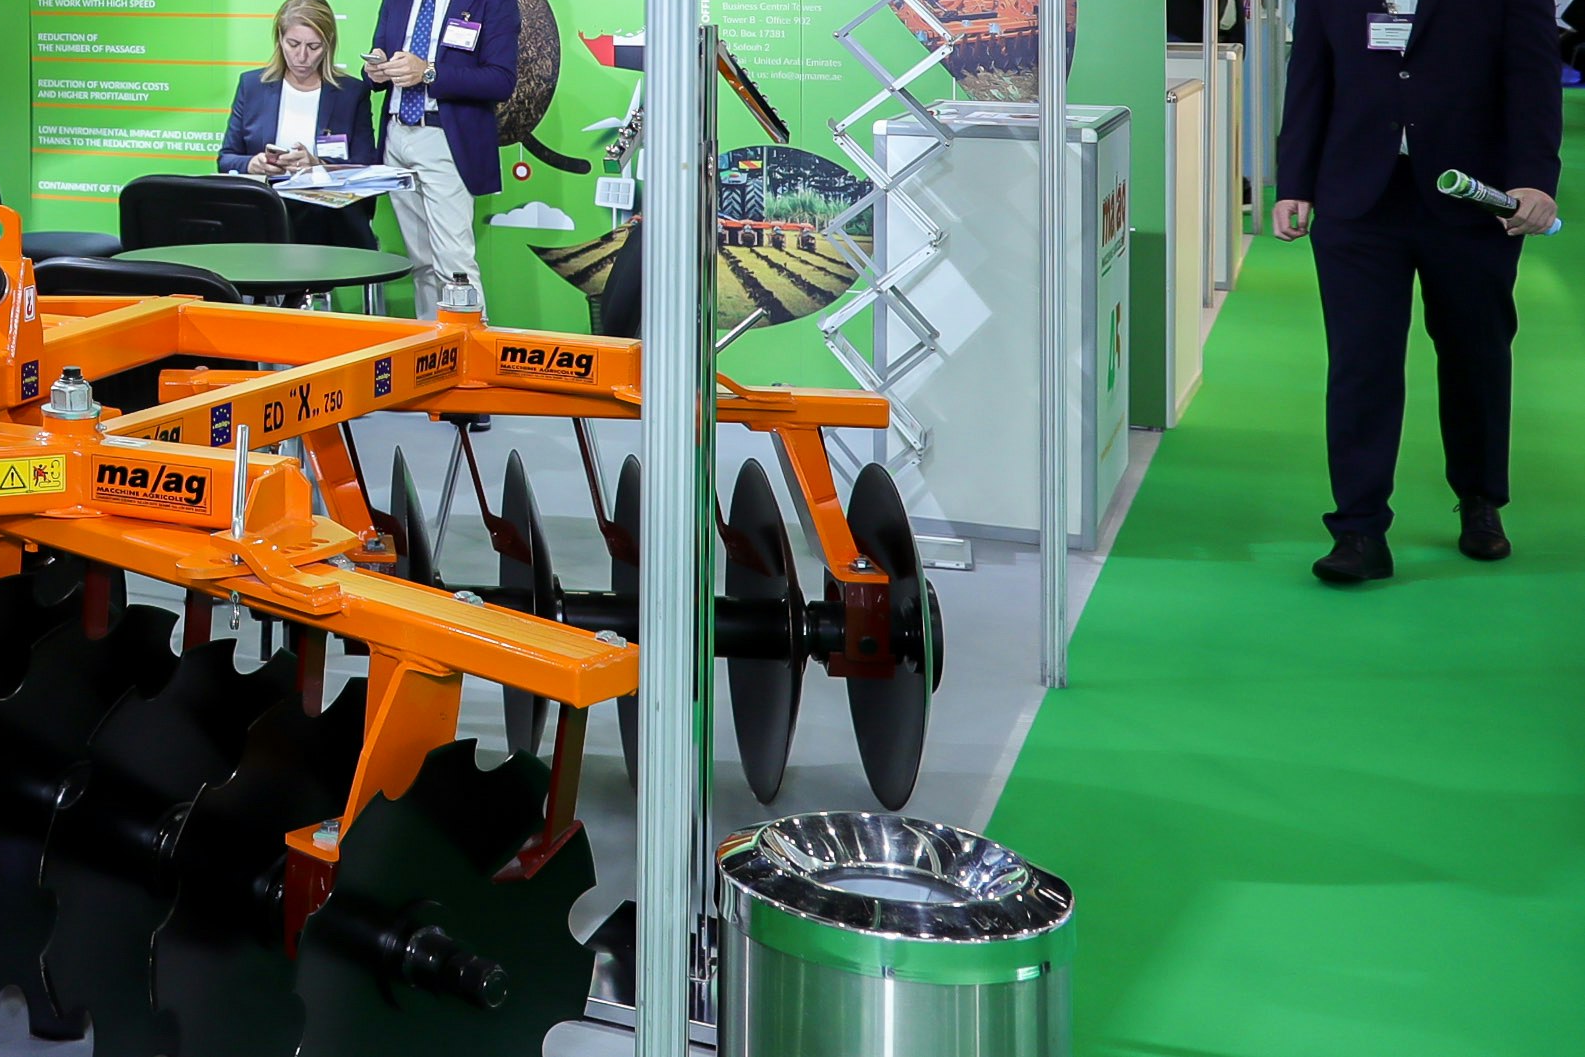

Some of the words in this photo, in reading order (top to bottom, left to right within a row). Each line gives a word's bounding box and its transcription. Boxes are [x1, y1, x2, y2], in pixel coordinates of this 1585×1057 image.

[55, 0, 81, 7] WORK
[83, 0, 104, 7] WITH
[129, 0, 155, 8] SPEED
[722, 2, 758, 11] Business
[760, 3, 790, 11] Central
[793, 3, 822, 12] Towers
[723, 16, 746, 24] Tower
[767, 16, 791, 24] Office
[37, 33, 85, 41] REDUCTION
[87, 34, 98, 42] OF
[760, 30, 785, 38] 17381
[37, 44, 53, 52] THE
[55, 44, 91, 52] NUMBER
[106, 45, 145, 54] PASSAGES
[783, 58, 802, 66] Arab
[806, 59, 842, 67] Emirates
[37, 80, 86, 88] REDUCTION
[87, 80, 99, 88] OF
[100, 81, 140, 90] WORKING
[142, 82, 169, 91] COSTS
[37, 90, 56, 98] AND
[58, 91, 89, 99] HIGHER
[90, 92, 149, 101] PROFITABILITY
[38, 125, 57, 134] LOW
[59, 126, 128, 137] ENVIRONMENTAL
[130, 129, 162, 138] IMPACT
[163, 130, 181, 139] AND
[183, 131, 214, 140] LOWER
[38, 136, 71, 145] THANKS
[72, 138, 84, 146] TO
[85, 138, 102, 147] THE
[103, 139, 151, 149] REDUCTION
[153, 141, 165, 149] OF
[166, 142, 183, 150] THE
[185, 143, 206, 152] FUEL
[38, 181, 98, 192] CONTAINMENT
[99, 183, 111, 192] OF
[416, 346, 457, 373] ma/ag
[501, 346, 593, 377] ma/ag
[264, 401, 284, 433] ED
[324, 390, 343, 413] 750
[97, 464, 206, 506] ma/ag
[96, 486, 139, 497] MACCHINE
[143, 492, 185, 502] AGRICOLE
